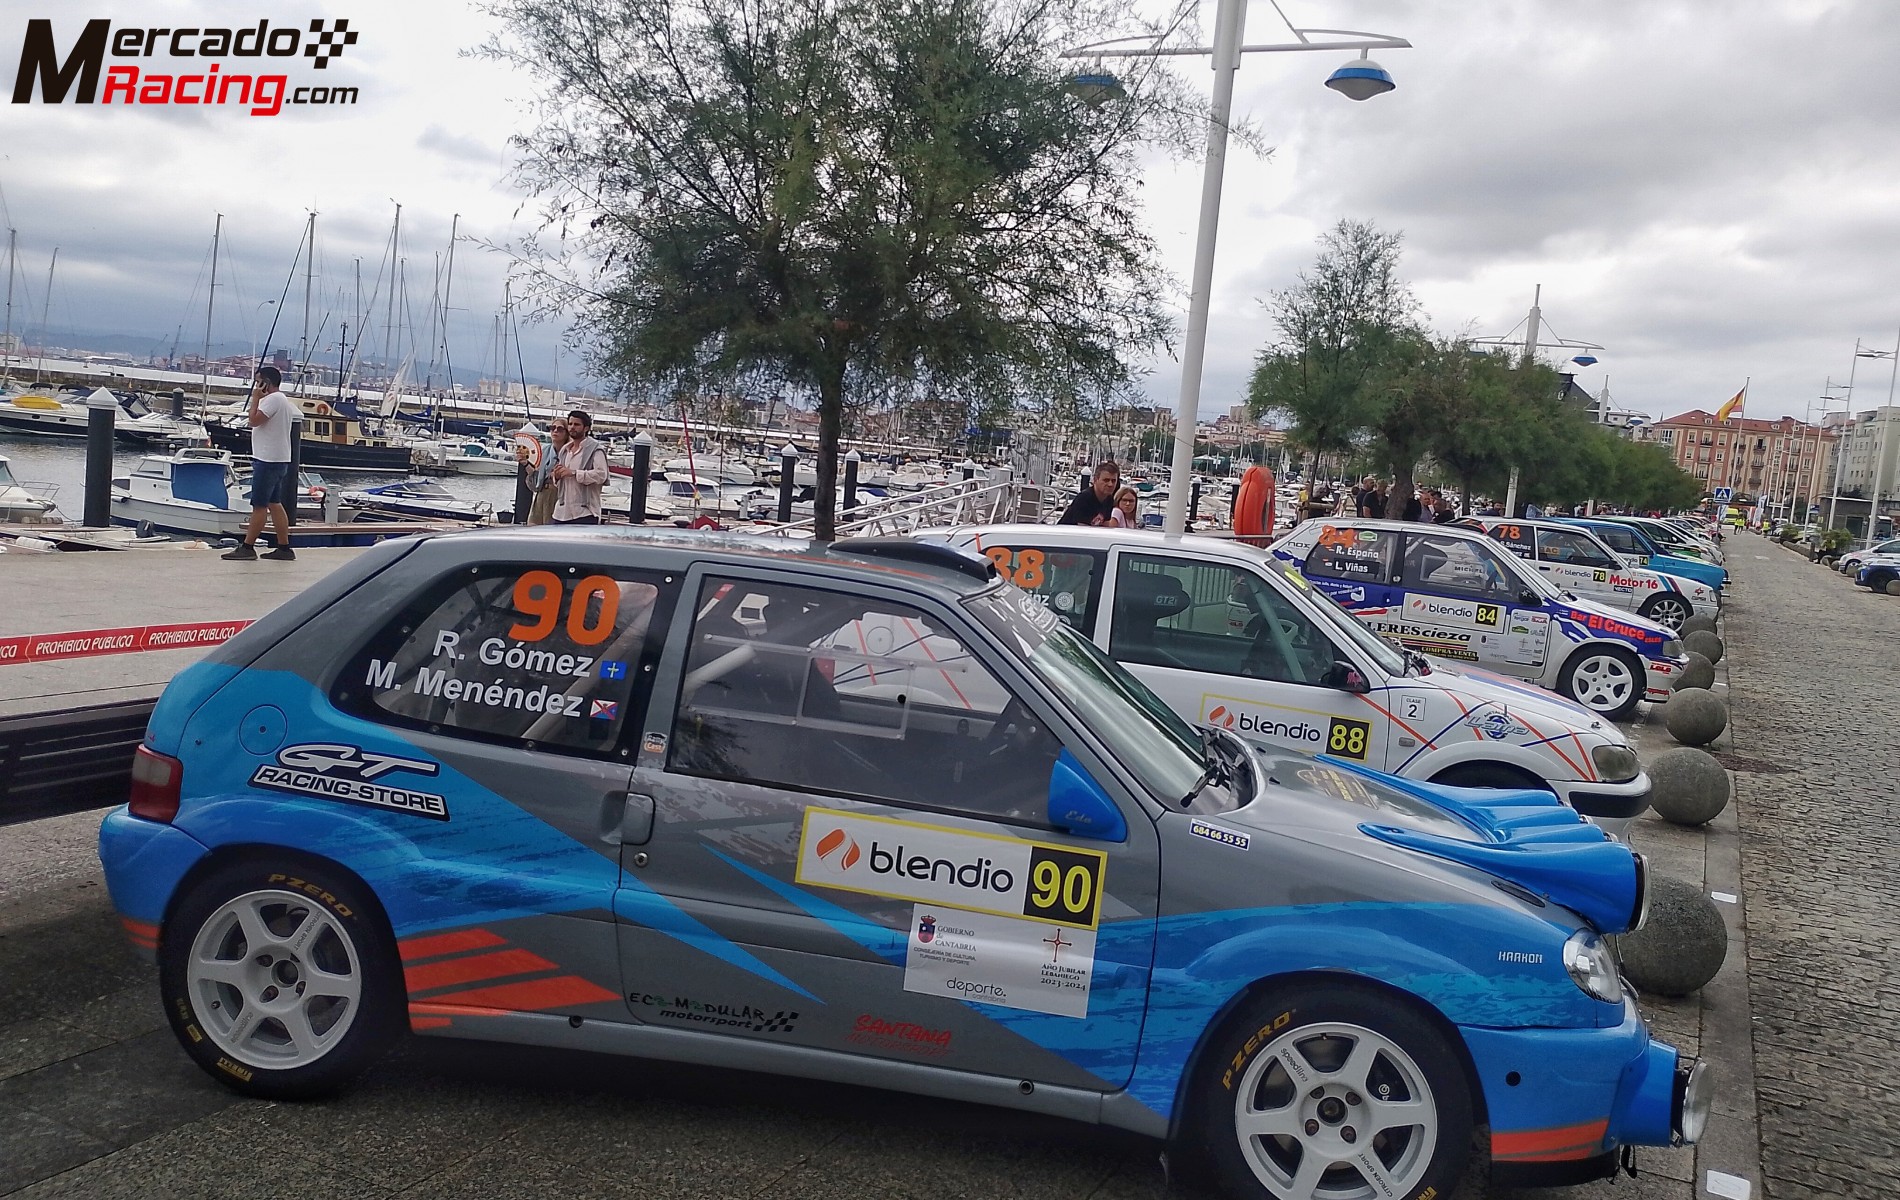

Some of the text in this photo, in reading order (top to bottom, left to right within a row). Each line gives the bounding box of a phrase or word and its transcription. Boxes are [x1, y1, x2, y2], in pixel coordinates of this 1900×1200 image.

[1498, 525, 1520, 539] 78
[1336, 546, 1379, 559] R. España
[1335, 562, 1368, 573] L. Viñas
[1640, 557, 1648, 565] 74
[1565, 569, 1606, 581] blendio 78
[1609, 575, 1645, 588] Motor
[1646, 579, 1658, 589] 16
[507, 570, 621, 646] 90
[1428, 603, 1473, 618] blendio
[1476, 607, 1496, 623] 84
[1570, 611, 1588, 622] Bar
[1588, 615, 1603, 629] El
[1604, 619, 1646, 640] Cruce
[148, 630, 198, 645] PROHIBIDO
[35, 640, 91, 656] PROHIBIDO
[433, 629, 594, 678] R. Gómez
[365, 659, 584, 718] M. Menéndez
[1408, 705, 1418, 718] 2
[1239, 713, 1365, 753] blendio 88
[257, 767, 442, 813] RACING-STORE
[1193, 824, 1247, 848] 684 66 55 55
[869, 841, 1092, 914] blendio 90
[937, 925, 975, 937] GOBIERNO
[935, 939, 977, 952] CANTABRIA
[919, 953, 942, 962] TURISMO
[946, 958, 970, 966] DEPORTE
[1040, 977, 1086, 992] 2023-2024
[659, 1008, 753, 1029] motorsport
[852, 1014, 953, 1048] SANTANA
